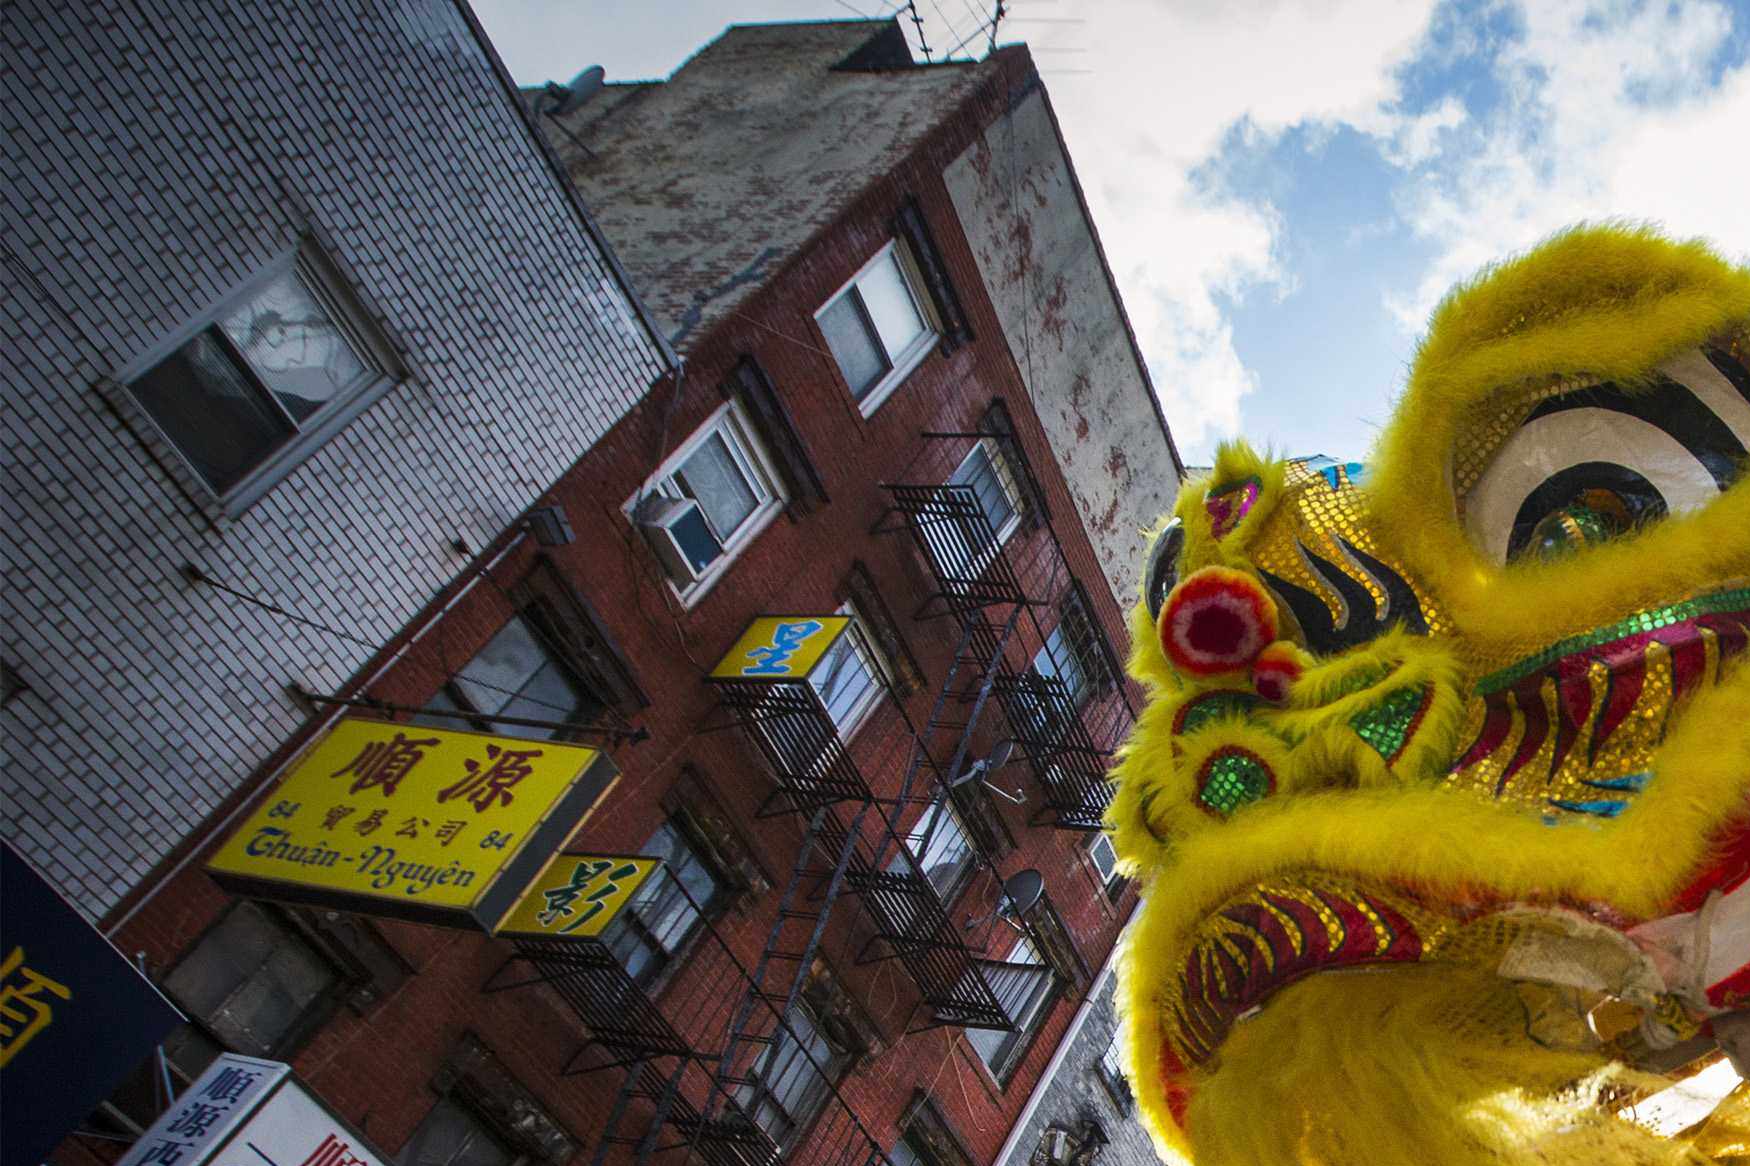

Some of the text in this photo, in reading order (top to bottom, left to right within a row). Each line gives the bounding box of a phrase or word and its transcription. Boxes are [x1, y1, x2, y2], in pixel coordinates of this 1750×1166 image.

[330, 732, 543, 814] 順源
[267, 799, 300, 820] 84
[319, 803, 468, 847] 貿易公司
[479, 830, 512, 852] 84
[534, 859, 640, 934] 影
